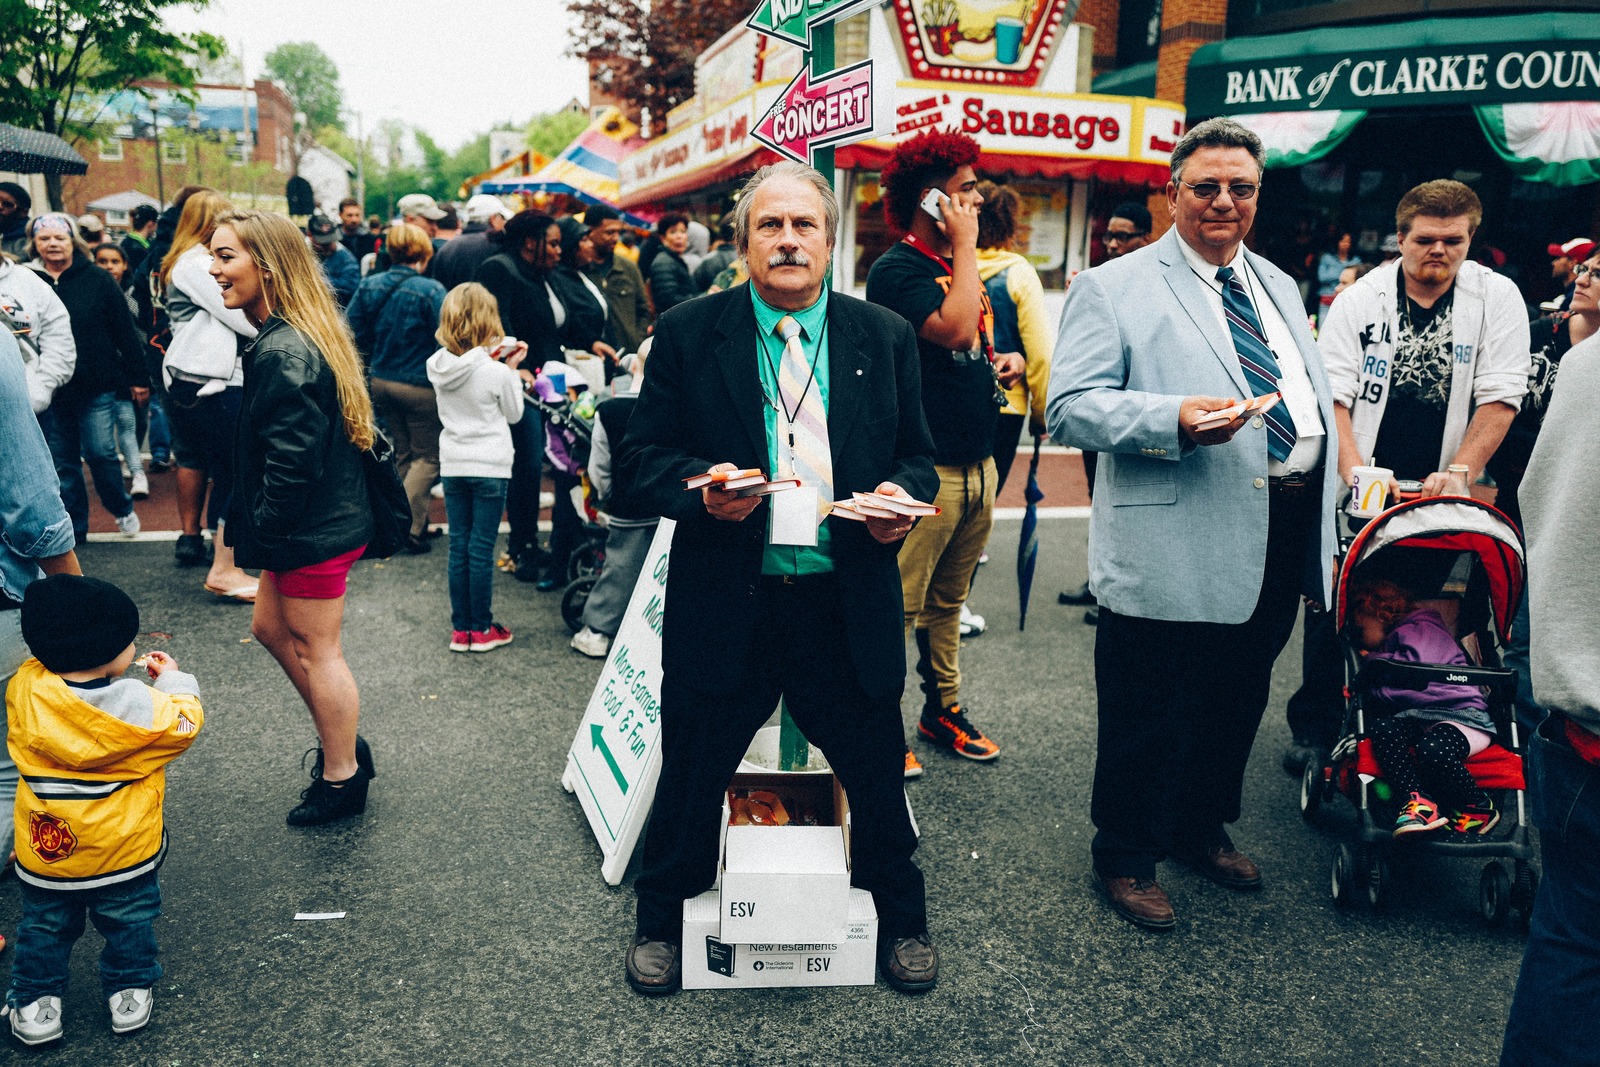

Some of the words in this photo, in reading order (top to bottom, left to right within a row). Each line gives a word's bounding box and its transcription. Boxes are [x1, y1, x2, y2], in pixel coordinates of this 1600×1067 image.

[1224, 66, 1303, 104] BANK
[1307, 58, 1351, 108] of
[1350, 53, 1488, 97] CLARKE
[1496, 50, 1600, 90] COUN
[769, 99, 787, 120] FREE
[772, 82, 869, 144] CONCERT
[962, 97, 1120, 150] Sausage
[1359, 380, 1383, 404] 19
[613, 644, 635, 685] More
[631, 670, 661, 724] Games
[1446, 673, 1468, 683] Jeep
[600, 678, 627, 719] Food
[619, 709, 635, 733] &
[626, 721, 647, 761] Fun
[730, 902, 755, 918] ESV
[749, 943, 774, 952] New
[778, 943, 838, 952] Testaments
[806, 957, 831, 972] ESV
